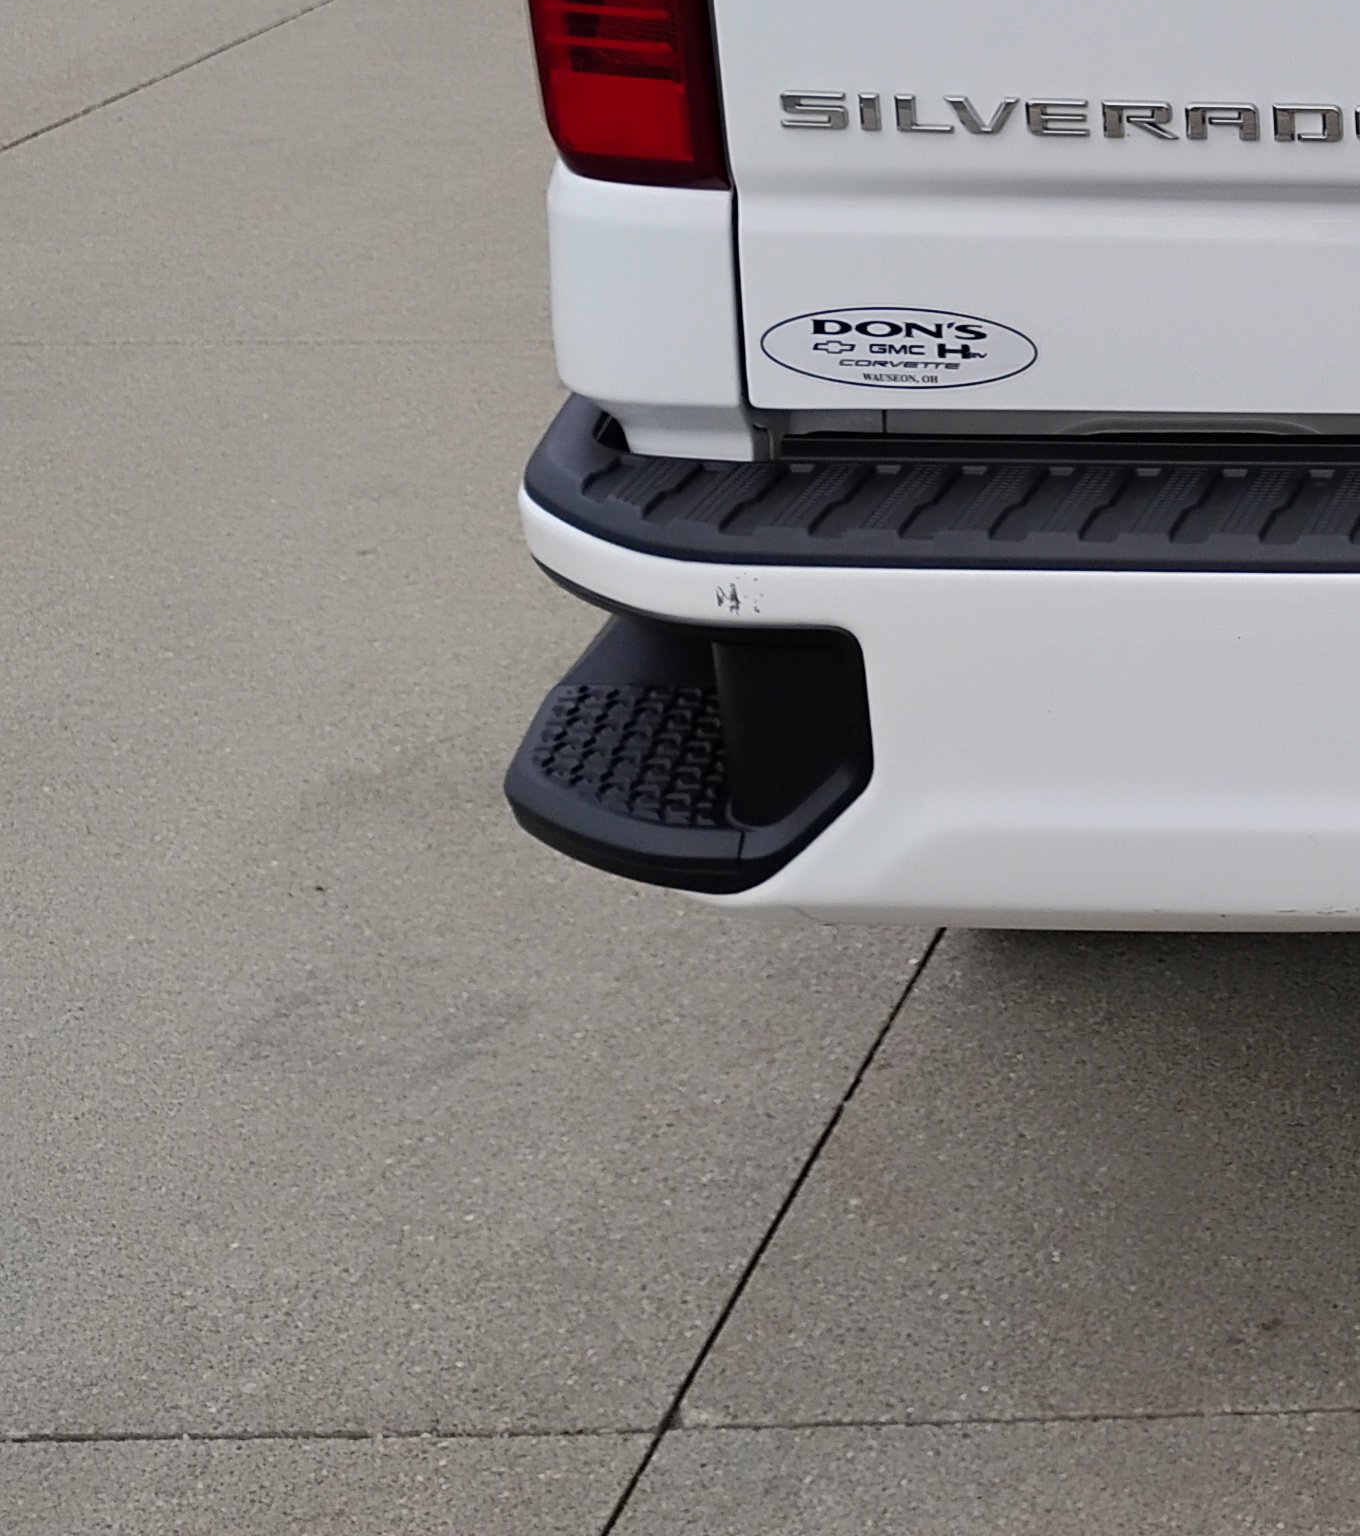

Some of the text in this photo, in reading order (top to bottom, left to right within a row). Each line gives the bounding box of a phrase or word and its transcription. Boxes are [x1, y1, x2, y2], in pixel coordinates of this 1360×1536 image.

[811, 319, 988, 340] DON'S
[869, 344, 926, 355] GMC
[839, 359, 961, 369] CORVETTE
[863, 373, 939, 384] WAUSEON, OH
